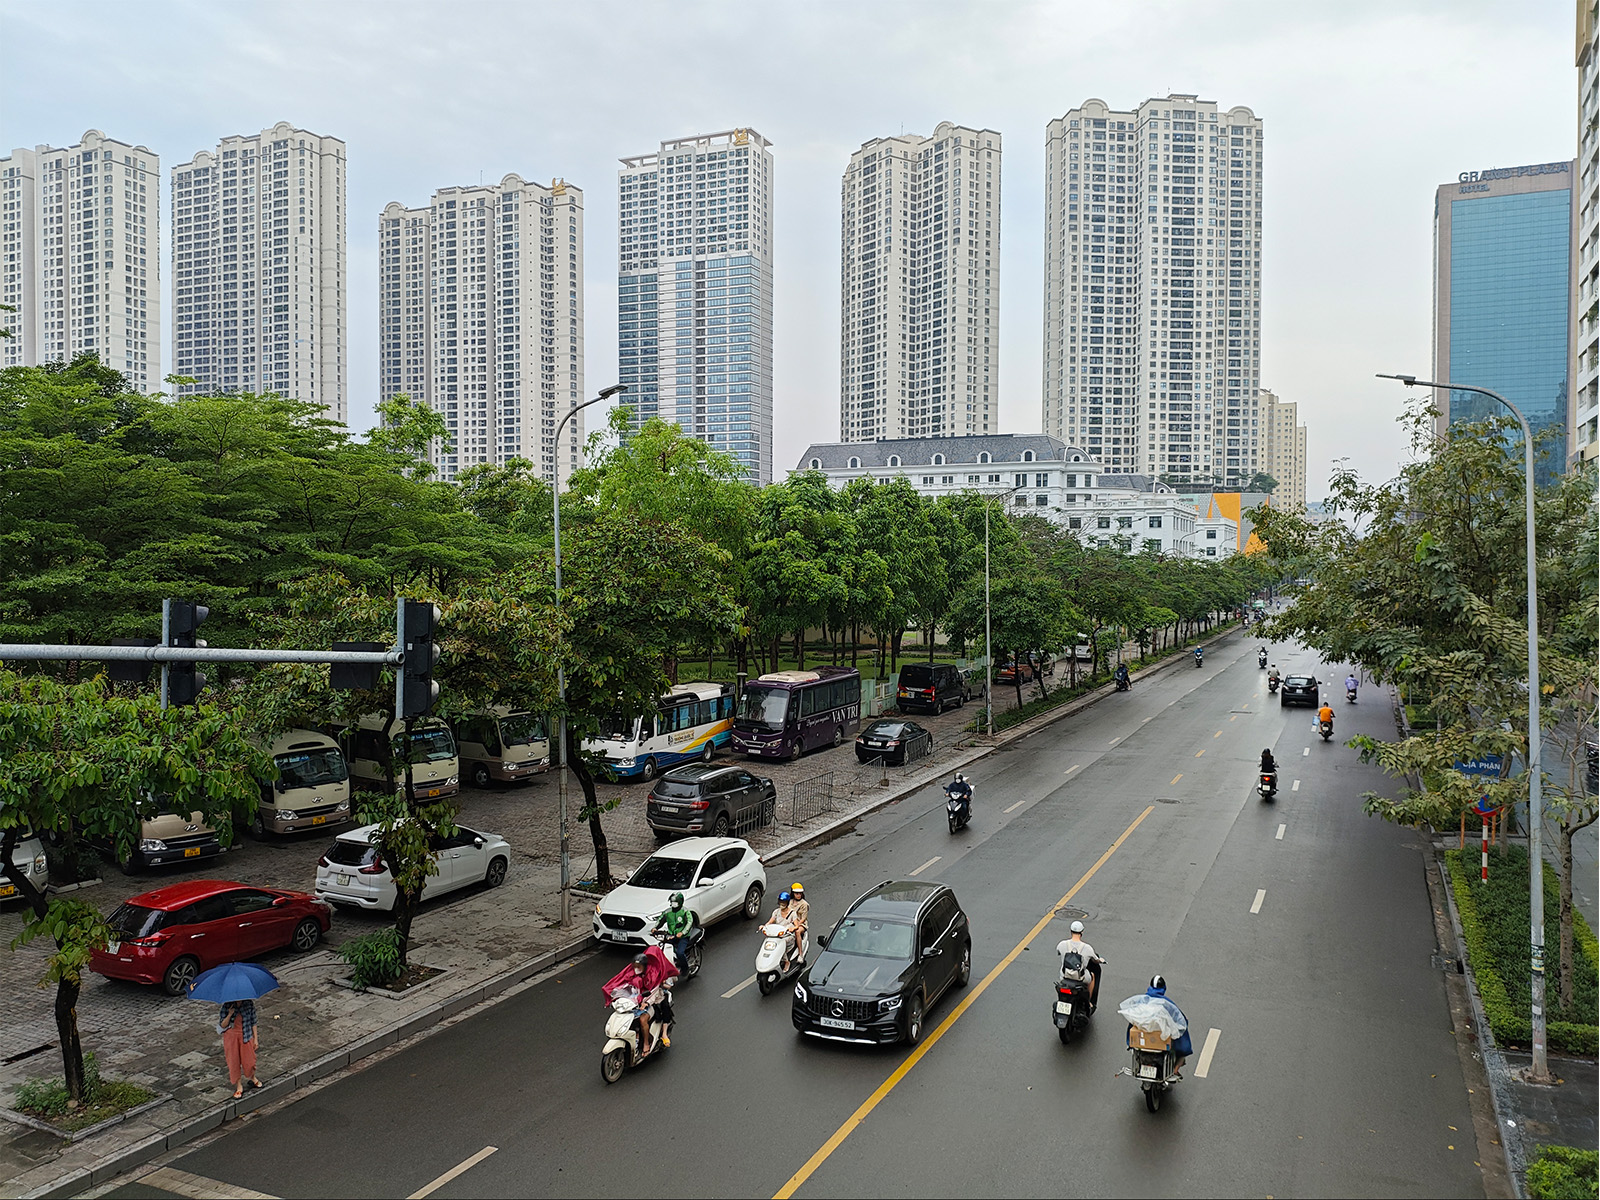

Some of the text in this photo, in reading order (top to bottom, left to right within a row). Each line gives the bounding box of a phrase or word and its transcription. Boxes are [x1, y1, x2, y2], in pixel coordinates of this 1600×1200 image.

[1458, 162, 1568, 183] GRAND PLAZA
[1459, 184, 1490, 194] HOTEL
